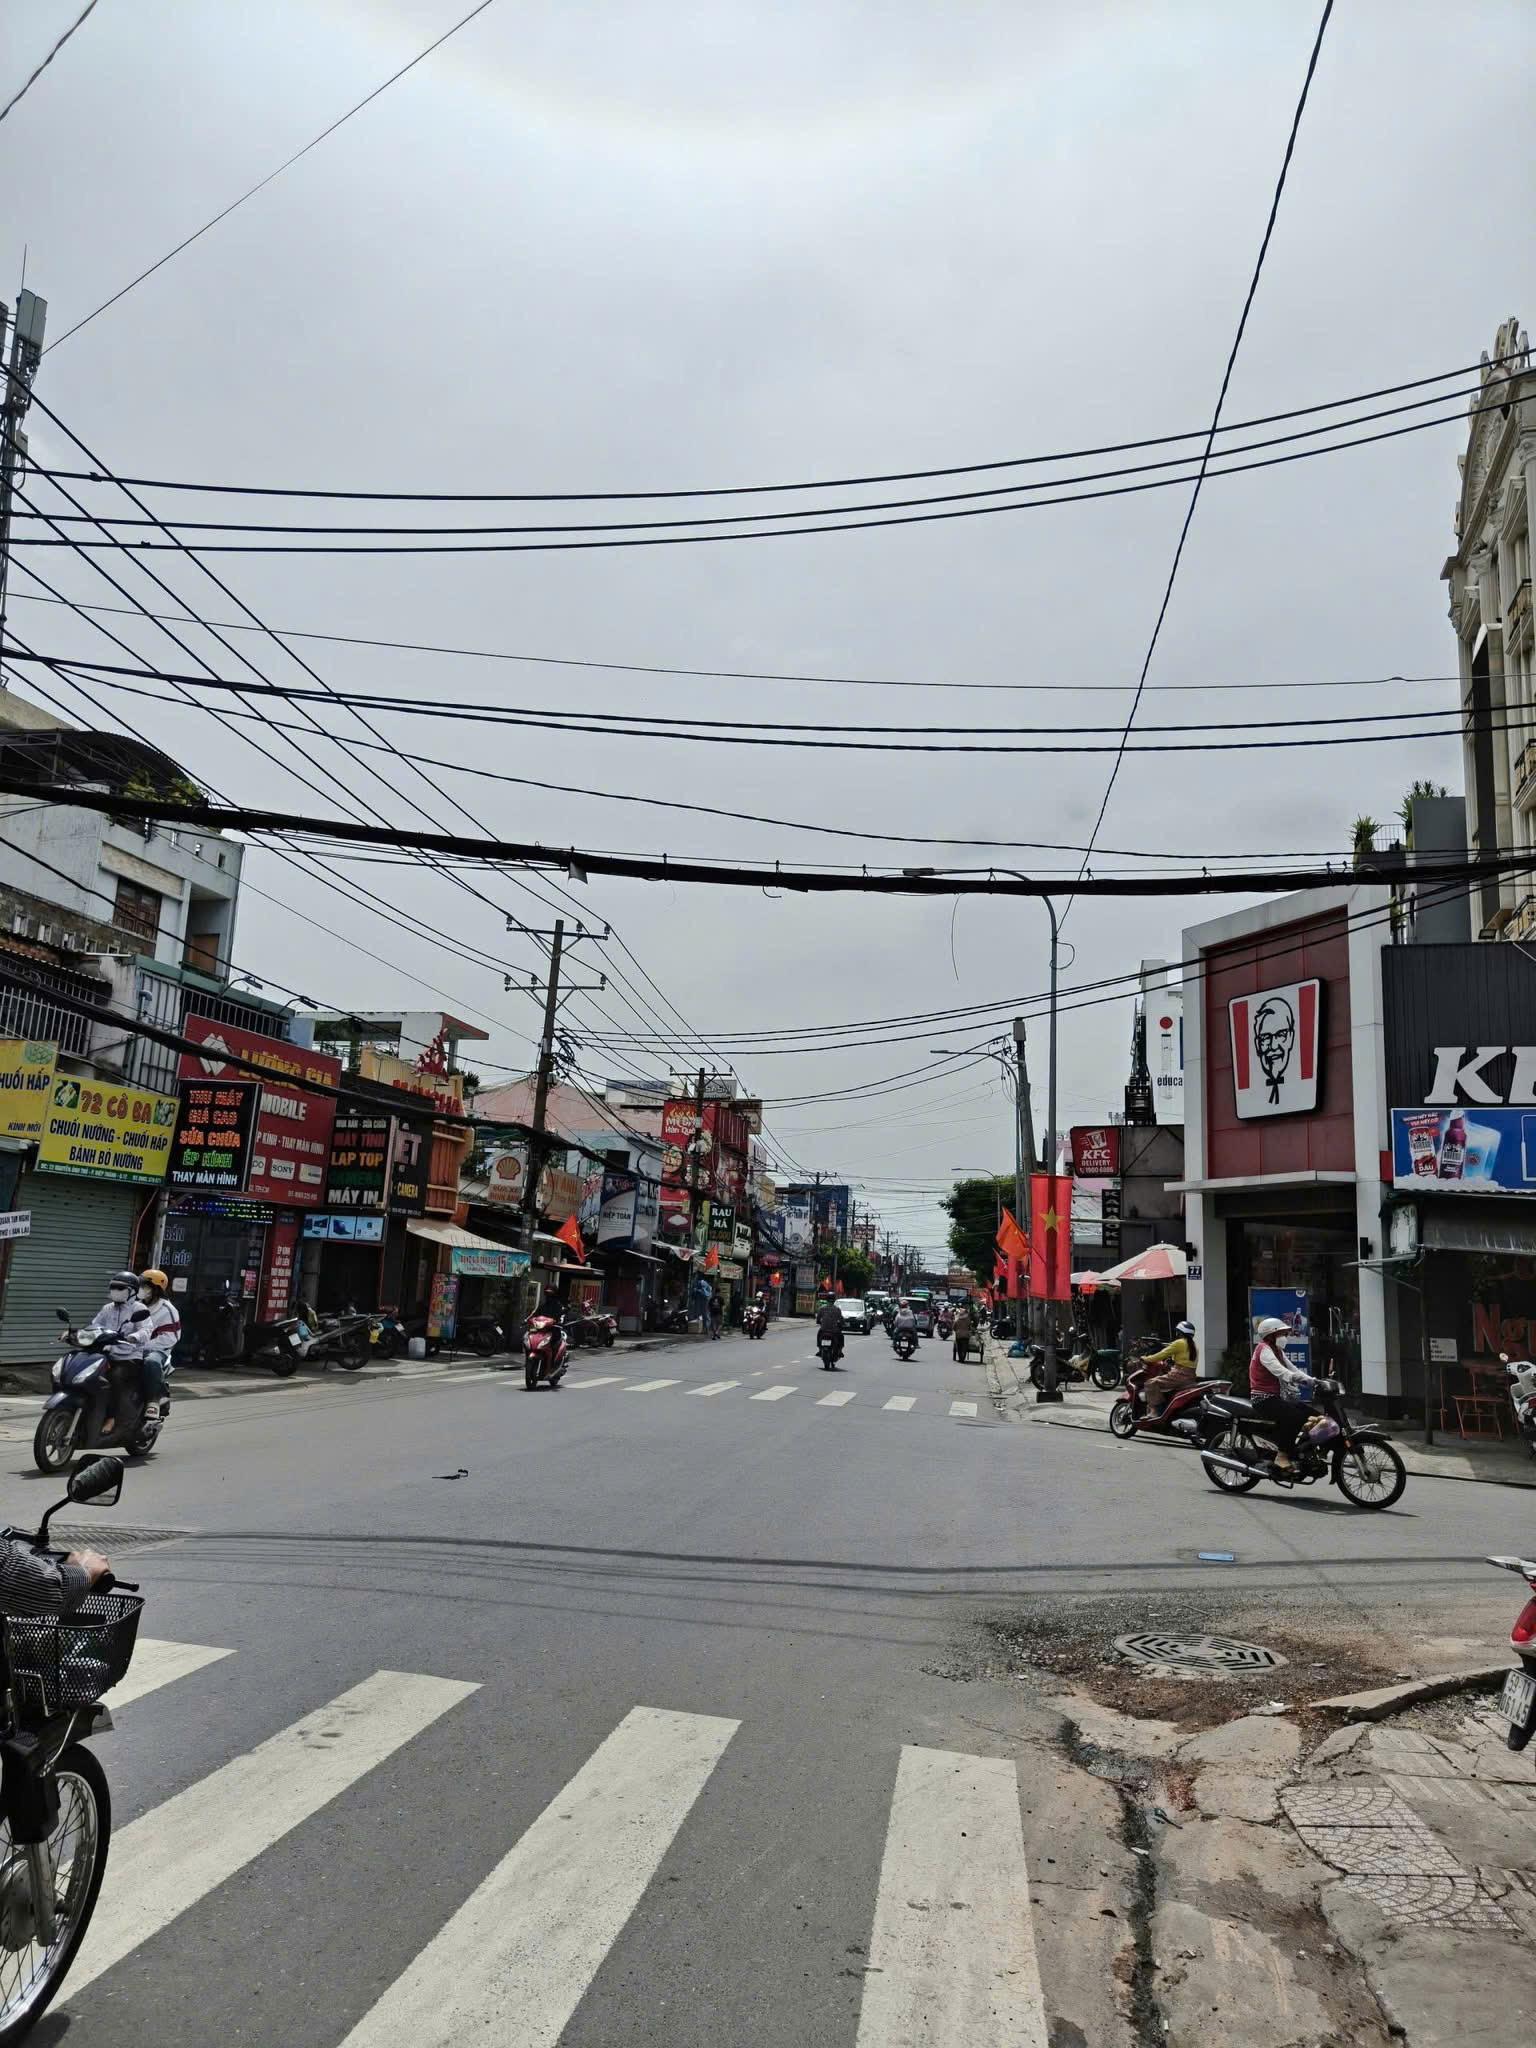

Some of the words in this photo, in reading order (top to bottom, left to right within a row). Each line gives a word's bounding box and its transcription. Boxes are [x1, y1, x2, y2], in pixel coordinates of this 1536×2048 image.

[27, 1067, 50, 1091] HẤP
[1157, 1075, 1183, 1087] educa
[81, 1090, 103, 1115] 72
[107, 1092, 129, 1120] CÔ
[132, 1100, 152, 1124] BA
[260, 1092, 307, 1121] MOBILE
[50, 1117, 80, 1138] CHUỐI
[82, 1123, 115, 1144] NƯỚNG
[123, 1130, 149, 1149] CHUỐI
[150, 1133, 168, 1152] HẤP
[180, 1127, 204, 1146] SỬA
[208, 1130, 240, 1148] CHỮA
[70, 1146, 95, 1165] BÁNH
[113, 1152, 144, 1171] NƯỚNG
[331, 1151, 356, 1166] LAP
[360, 1151, 384, 1168] TOP
[1081, 1149, 1111, 1160] KFC
[272, 1164, 293, 1174] SONY
[1081, 1160, 1111, 1168] DELIVERY
[172, 1170, 195, 1183] THAY
[196, 1169, 215, 1185] MÀN
[216, 1171, 238, 1185] HÌNH
[328, 1187, 360, 1205] MÁY
[362, 1190, 379, 1205] IN
[397, 1181, 418, 1199] CAMERA
[712, 1207, 732, 1217] RAU
[1104, 1191, 1120, 1247] KARAOKE
[713, 1218, 727, 1229] MÁ
[173, 1247, 192, 1266] GÓP
[1189, 1266, 1201, 1275] 77
